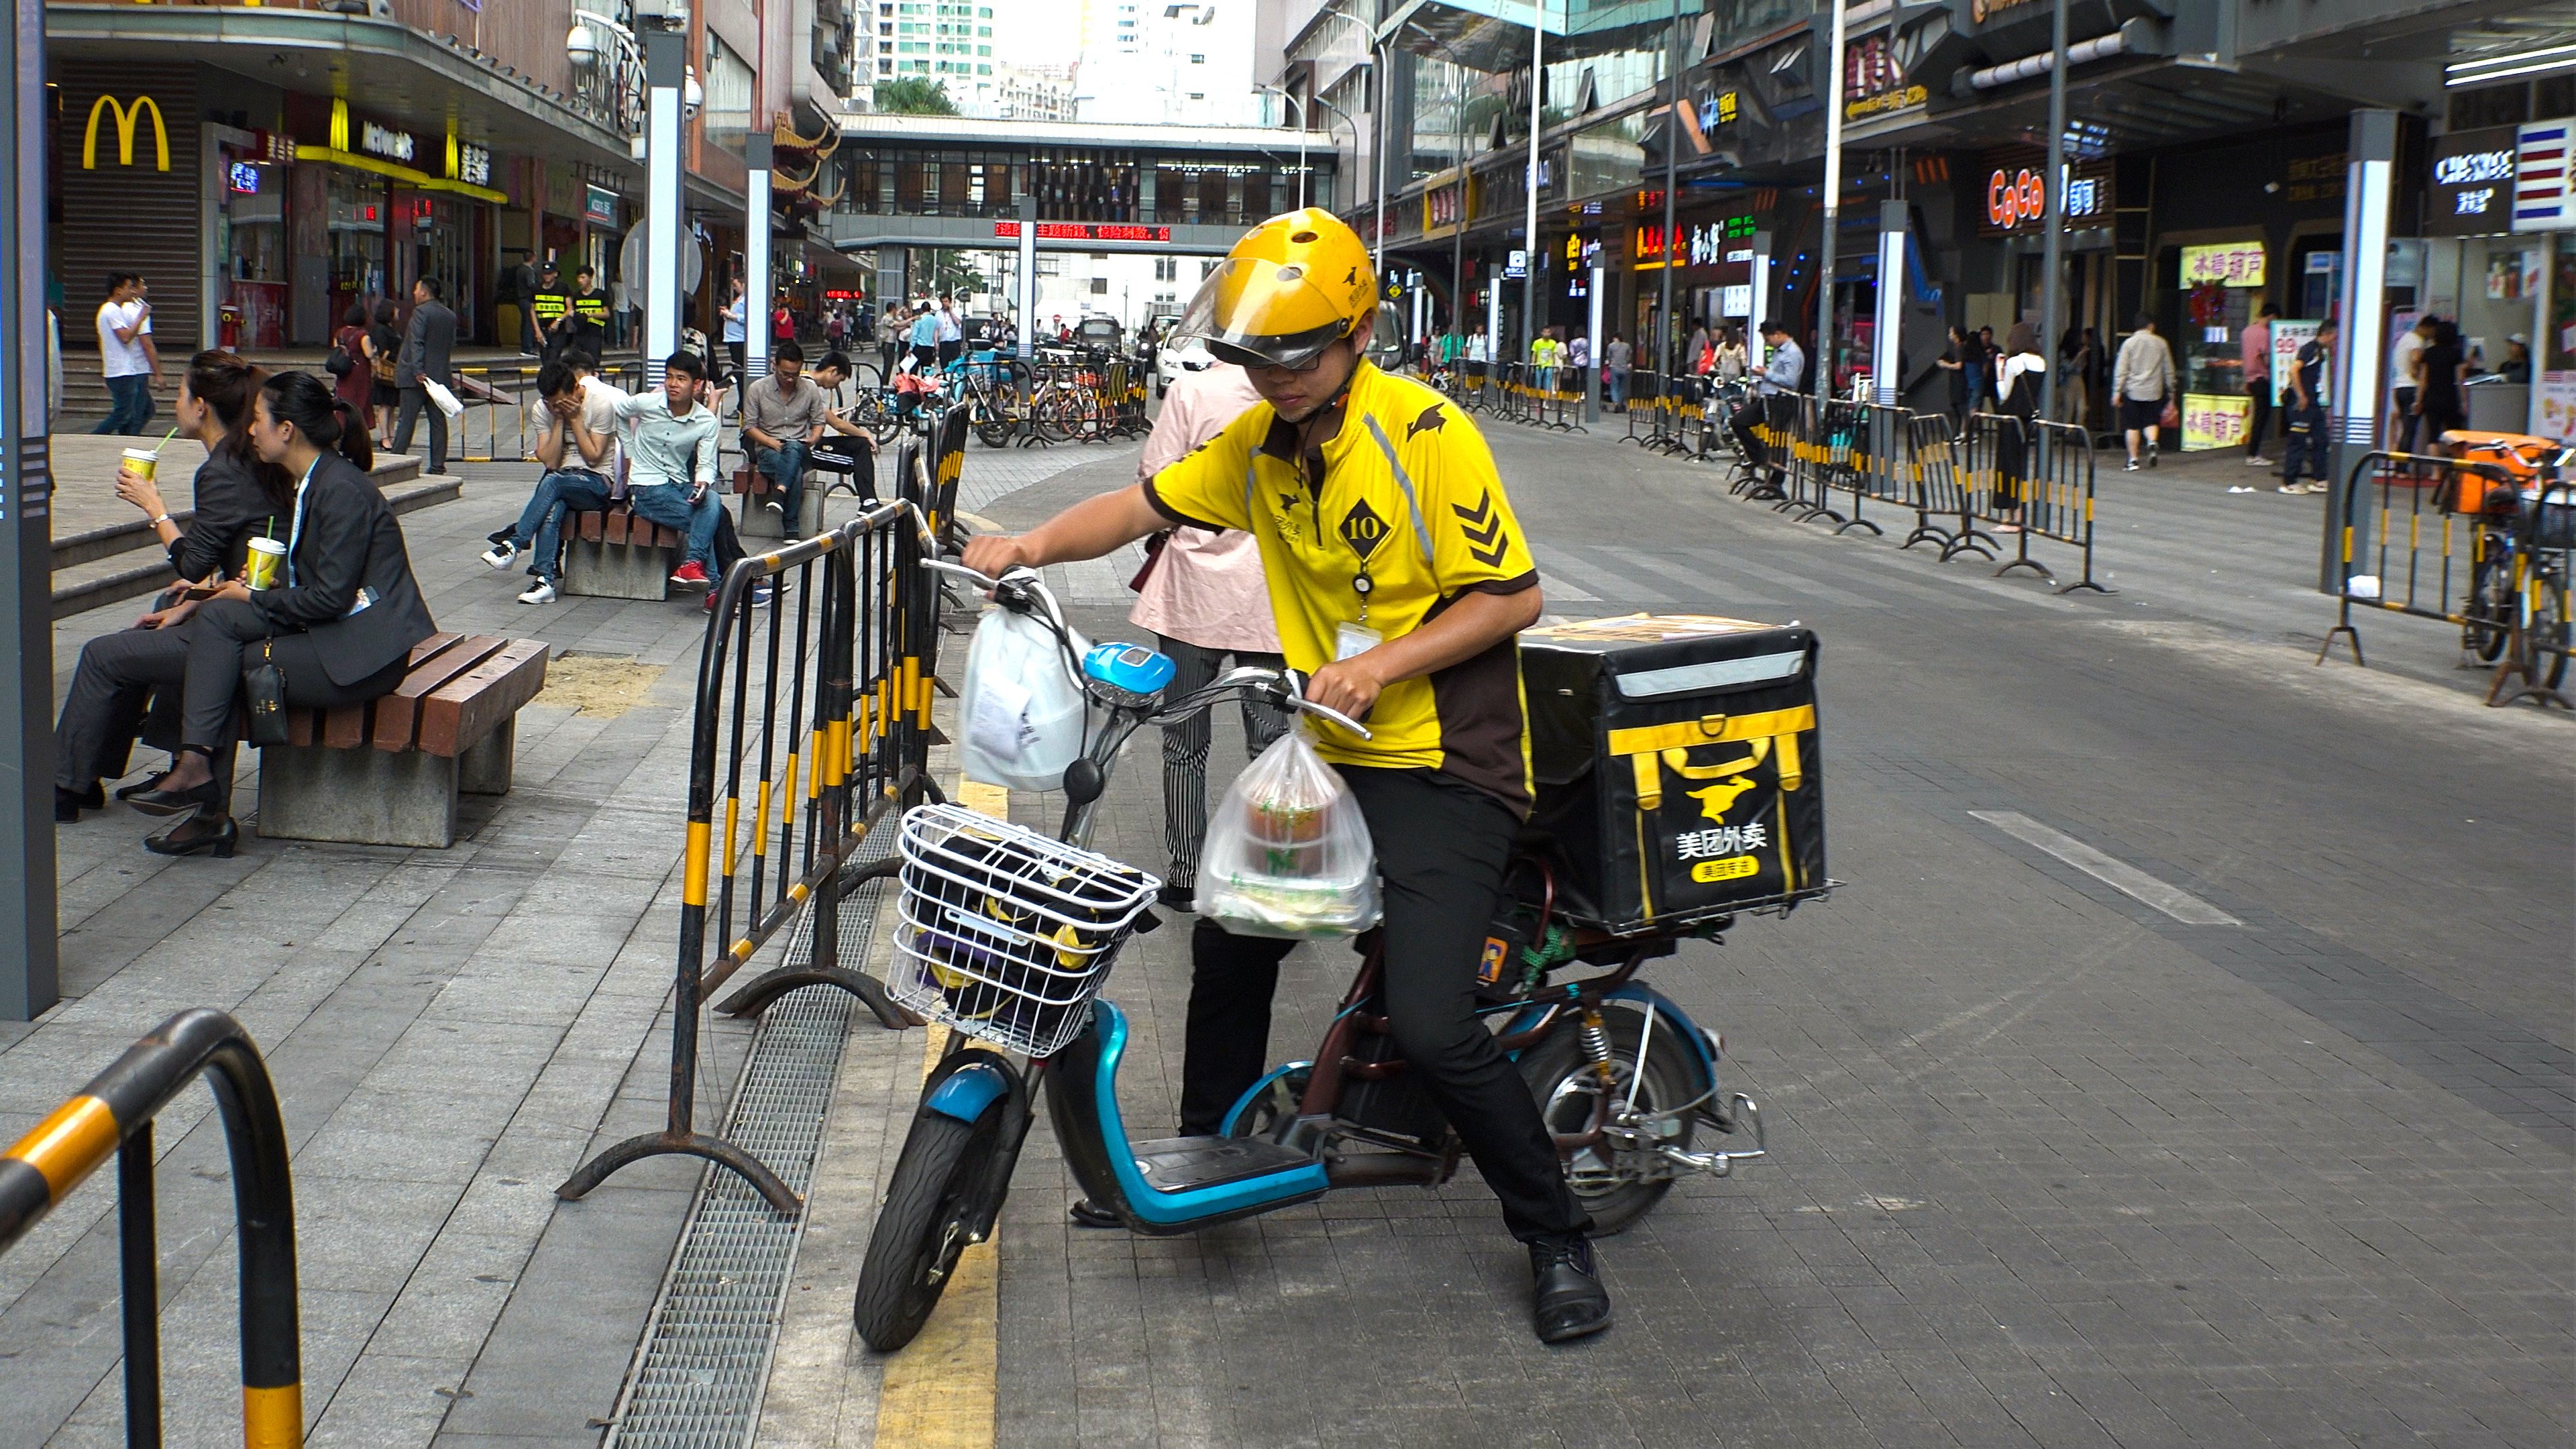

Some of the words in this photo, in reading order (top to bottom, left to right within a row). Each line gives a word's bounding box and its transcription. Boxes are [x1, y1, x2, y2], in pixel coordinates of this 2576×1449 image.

[1349, 517, 1380, 539] 10
[1676, 822, 1768, 860] 美团外卖
